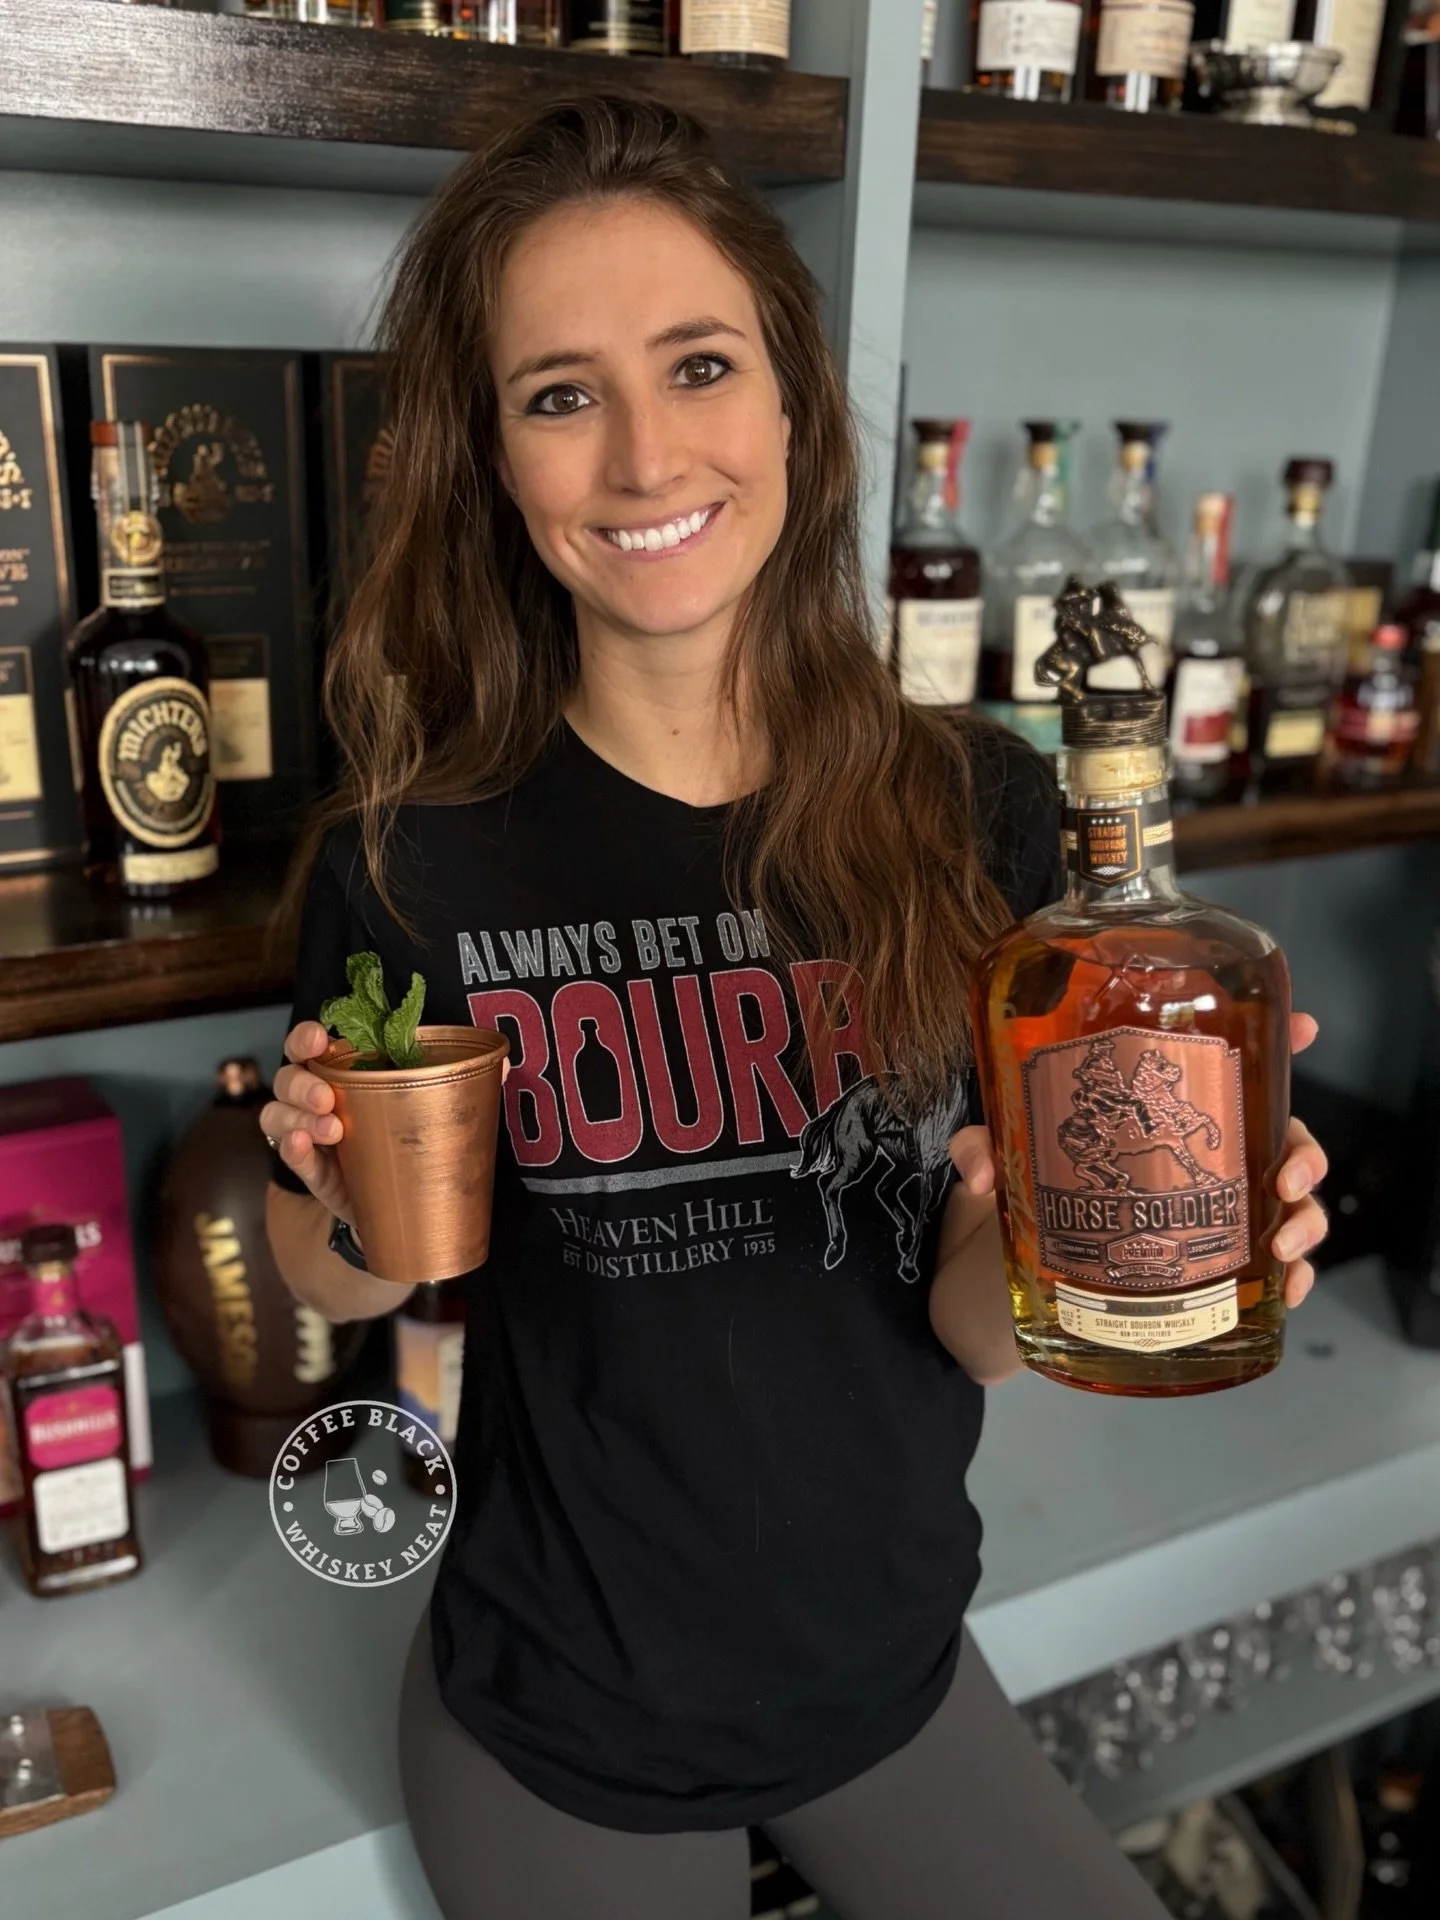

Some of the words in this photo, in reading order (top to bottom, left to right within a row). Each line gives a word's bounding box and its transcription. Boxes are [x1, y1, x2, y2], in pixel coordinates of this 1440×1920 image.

[1087, 825, 1128, 838] STRAIGHT
[1089, 838, 1127, 851] BOURBON
[1090, 851, 1128, 865] WHISKEY
[457, 919, 622, 986] ALWAYS
[632, 915, 701, 971] BET
[716, 908, 771, 963] ON
[1043, 1192, 1121, 1231] HORSE
[1133, 1187, 1239, 1230] SOLDIER
[550, 1207, 678, 1249] HEAVEN
[683, 1198, 775, 1236] HILL
[563, 1249, 583, 1266] EST
[585, 1238, 735, 1280] DISTILLERY
[743, 1237, 777, 1257] 1935
[1121, 1248, 1164, 1260] PREMIUM
[1095, 1318, 1128, 1330] STRAIGHT
[1130, 1319, 1162, 1330] BOURBON
[1164, 1317, 1196, 1329] WHISKEY
